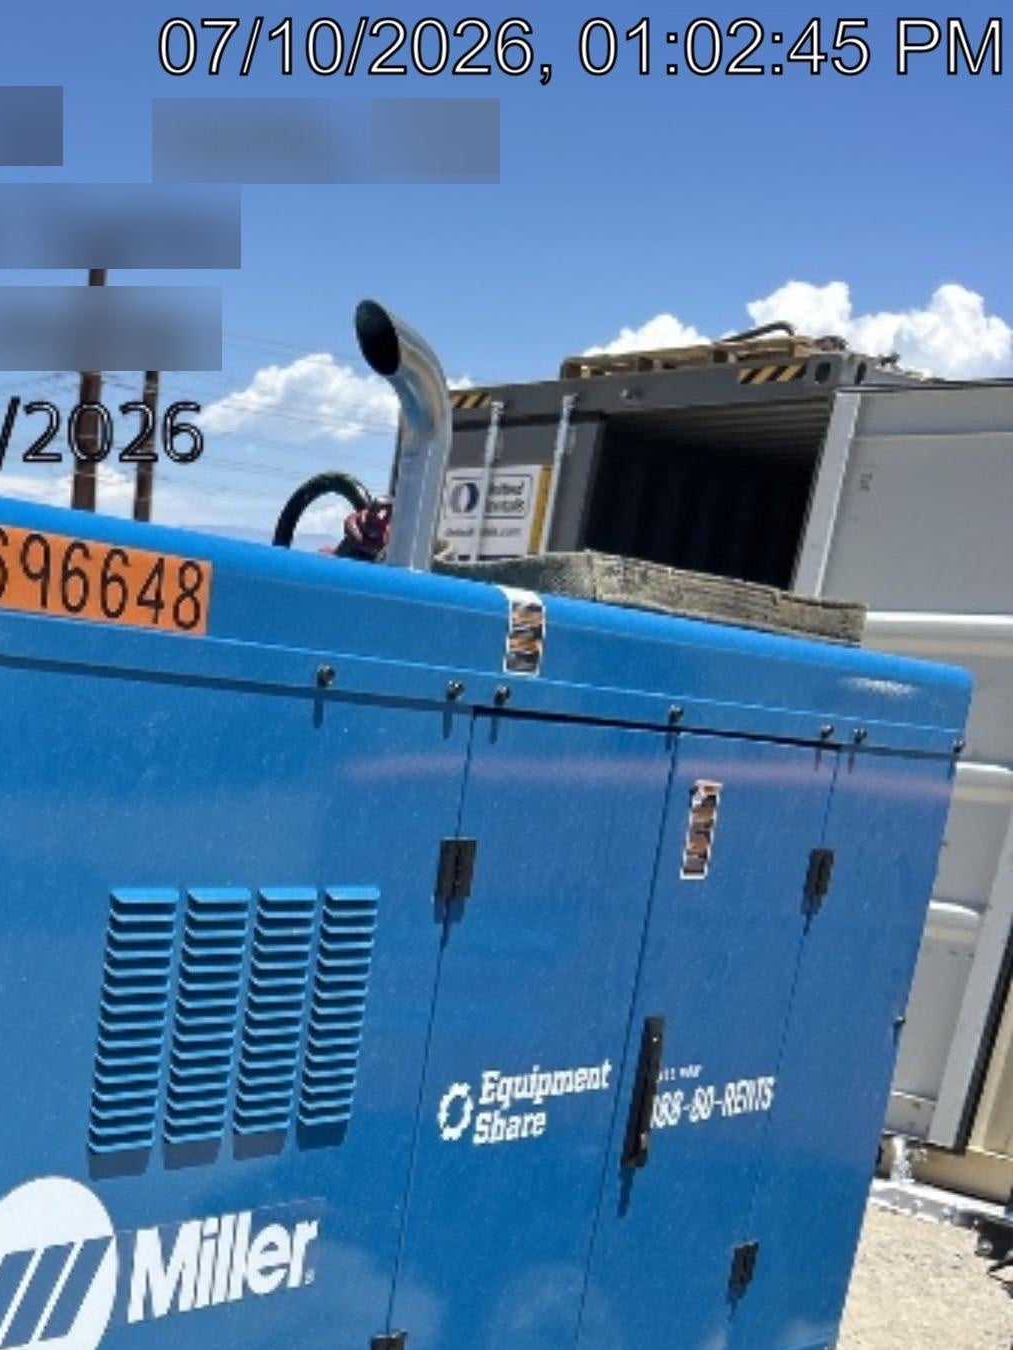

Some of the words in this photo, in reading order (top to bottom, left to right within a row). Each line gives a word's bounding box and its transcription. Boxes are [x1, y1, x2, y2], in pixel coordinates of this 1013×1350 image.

[479, 1059, 613, 1110] Equipment
[472, 1109, 548, 1145] Share
[127, 1211, 319, 1324] Miller
